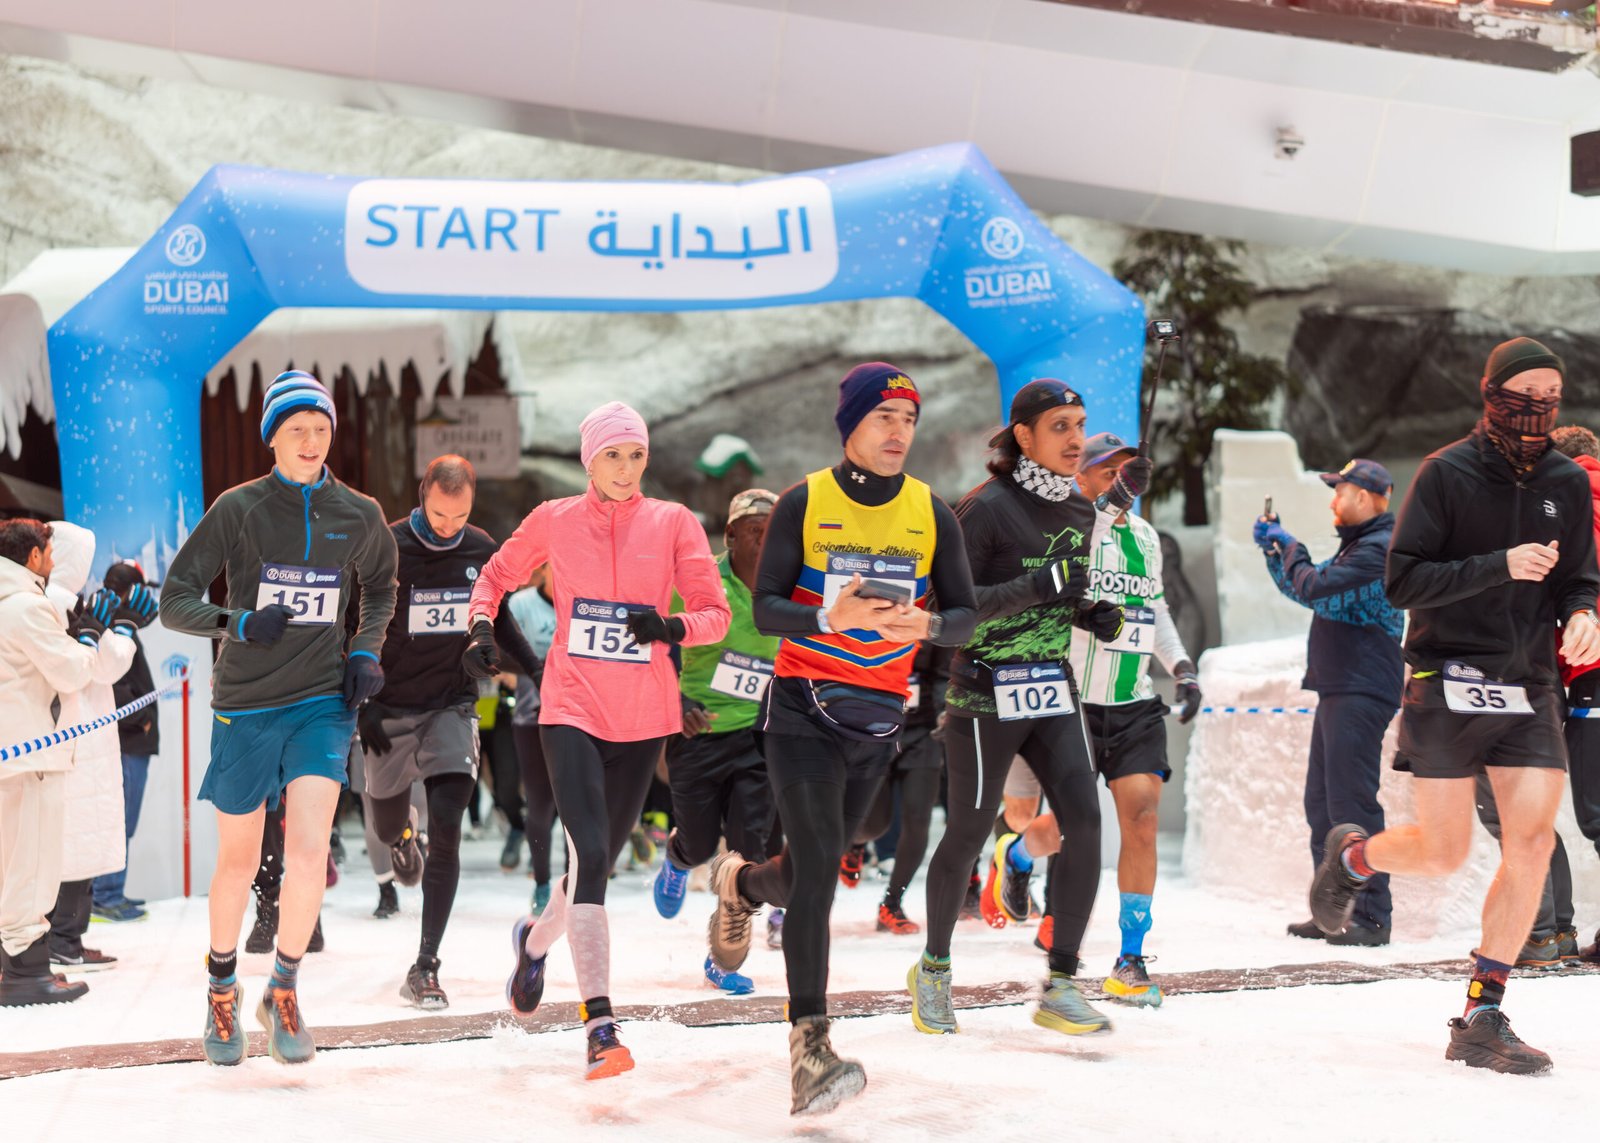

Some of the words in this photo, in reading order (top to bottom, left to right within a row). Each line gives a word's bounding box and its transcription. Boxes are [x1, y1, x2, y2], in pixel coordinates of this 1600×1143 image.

[365, 204, 560, 252] START
[588, 206, 812, 270] البداية
[144, 281, 229, 303] DUBAI
[965, 270, 1052, 298] DUBAI
[144, 304, 184, 315] SPORTS
[186, 304, 228, 315] COUNCIL
[278, 571, 302, 581] DUBAI
[273, 590, 326, 617] 151
[589, 606, 613, 616] DUBAI
[425, 607, 456, 628] 34
[584, 625, 640, 655] 152
[1128, 627, 1141, 647] 4
[734, 673, 759, 695] 18
[1008, 685, 1061, 712] 102
[1466, 687, 1507, 709] 35
